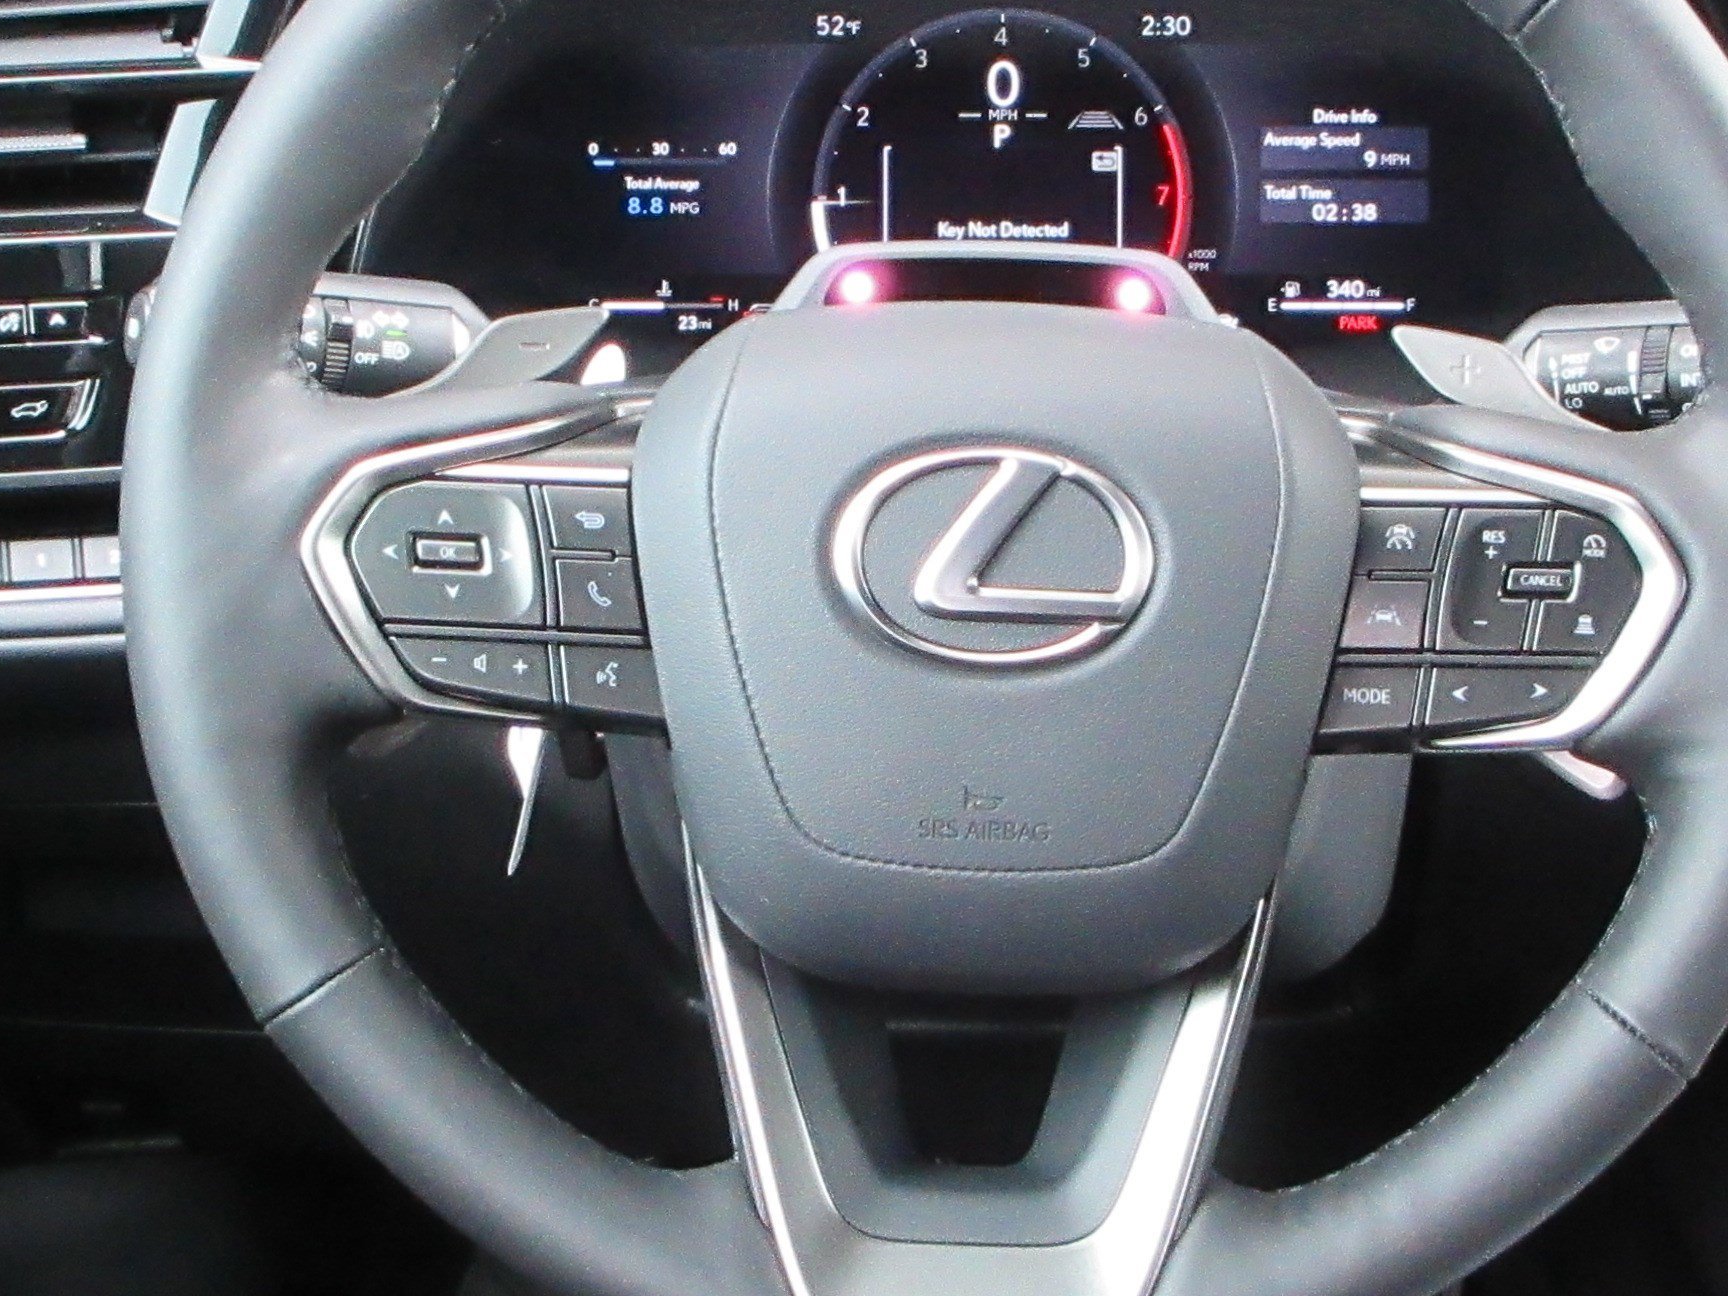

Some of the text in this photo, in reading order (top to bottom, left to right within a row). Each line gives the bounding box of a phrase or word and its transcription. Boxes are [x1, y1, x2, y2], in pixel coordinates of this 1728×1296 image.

[1141, 14, 1192, 38] 2:30
[993, 26, 1009, 46] 4
[914, 50, 929, 68] 3
[1077, 47, 1091, 67] 5
[985, 59, 1022, 108] 0
[856, 107, 870, 127] 2
[987, 108, 1019, 123] MPH
[1133, 107, 1149, 127] 6
[1312, 108, 1379, 124] Drive Info
[993, 123, 1012, 149] P
[1262, 131, 1361, 150] Average Speed
[587, 141, 738, 156] 0 30 60
[1363, 150, 1411, 168] 9 MPH
[624, 176, 701, 193] Total Average
[1262, 184, 1334, 201] Total Time
[836, 185, 847, 208] 1
[1157, 185, 1170, 206] 7
[626, 196, 701, 215] 8.8 MPG
[937, 220, 1070, 240] Key Not Detected
[1326, 278, 1365, 299] 340
[727, 299, 740, 312] H
[1267, 298, 1278, 313] E
[1405, 298, 1416, 313] F
[1338, 315, 1378, 331] PARK
[354, 351, 380, 365] OFF
[1562, 366, 1588, 380] OFF
[1564, 380, 1600, 395] AUTO
[1602, 385, 1630, 396] AUTO
[1564, 396, 1584, 410] LO
[1481, 529, 1507, 544] RES
[438, 545, 457, 559] OK
[1519, 574, 1563, 587] CANCEL
[1342, 687, 1391, 705] MODE
[918, 818, 1051, 843] SRS AIRBAG
